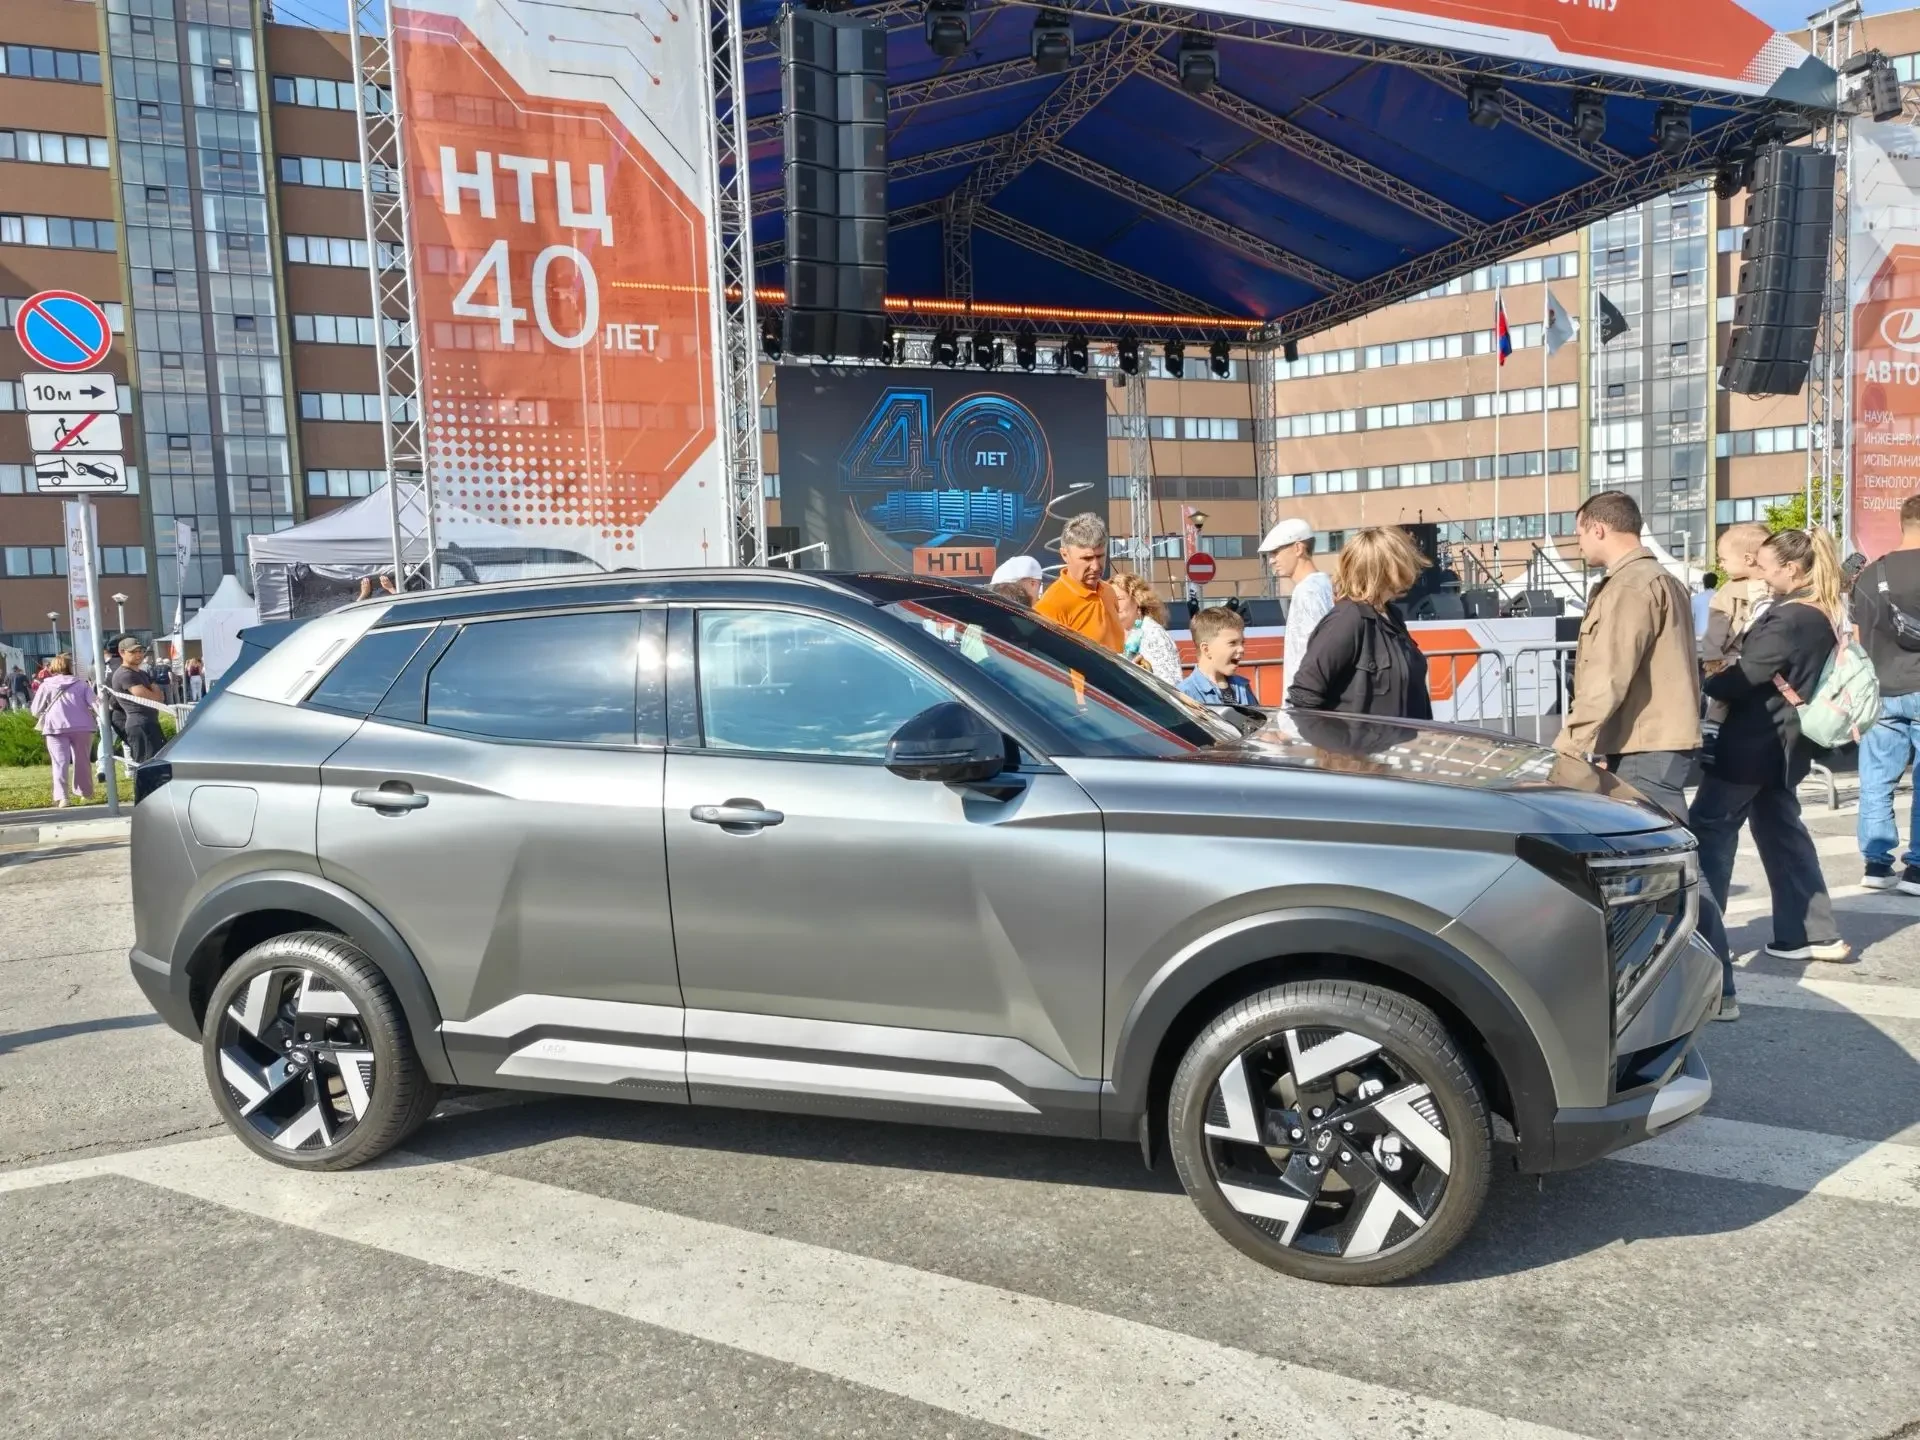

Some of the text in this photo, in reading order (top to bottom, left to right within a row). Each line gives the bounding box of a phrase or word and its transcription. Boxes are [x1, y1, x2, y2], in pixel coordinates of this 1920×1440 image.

[439, 146, 614, 247] НТЦ
[452, 239, 660, 351] 40 ЛЕТ
[1864, 360, 1920, 386] АВТО
[1864, 410, 1895, 424] НАУКА
[975, 451, 1007, 466] ЛЕТ
[1863, 453, 1920, 468] ИСПЫТАНИ
[927, 552, 984, 575] НТЦ
